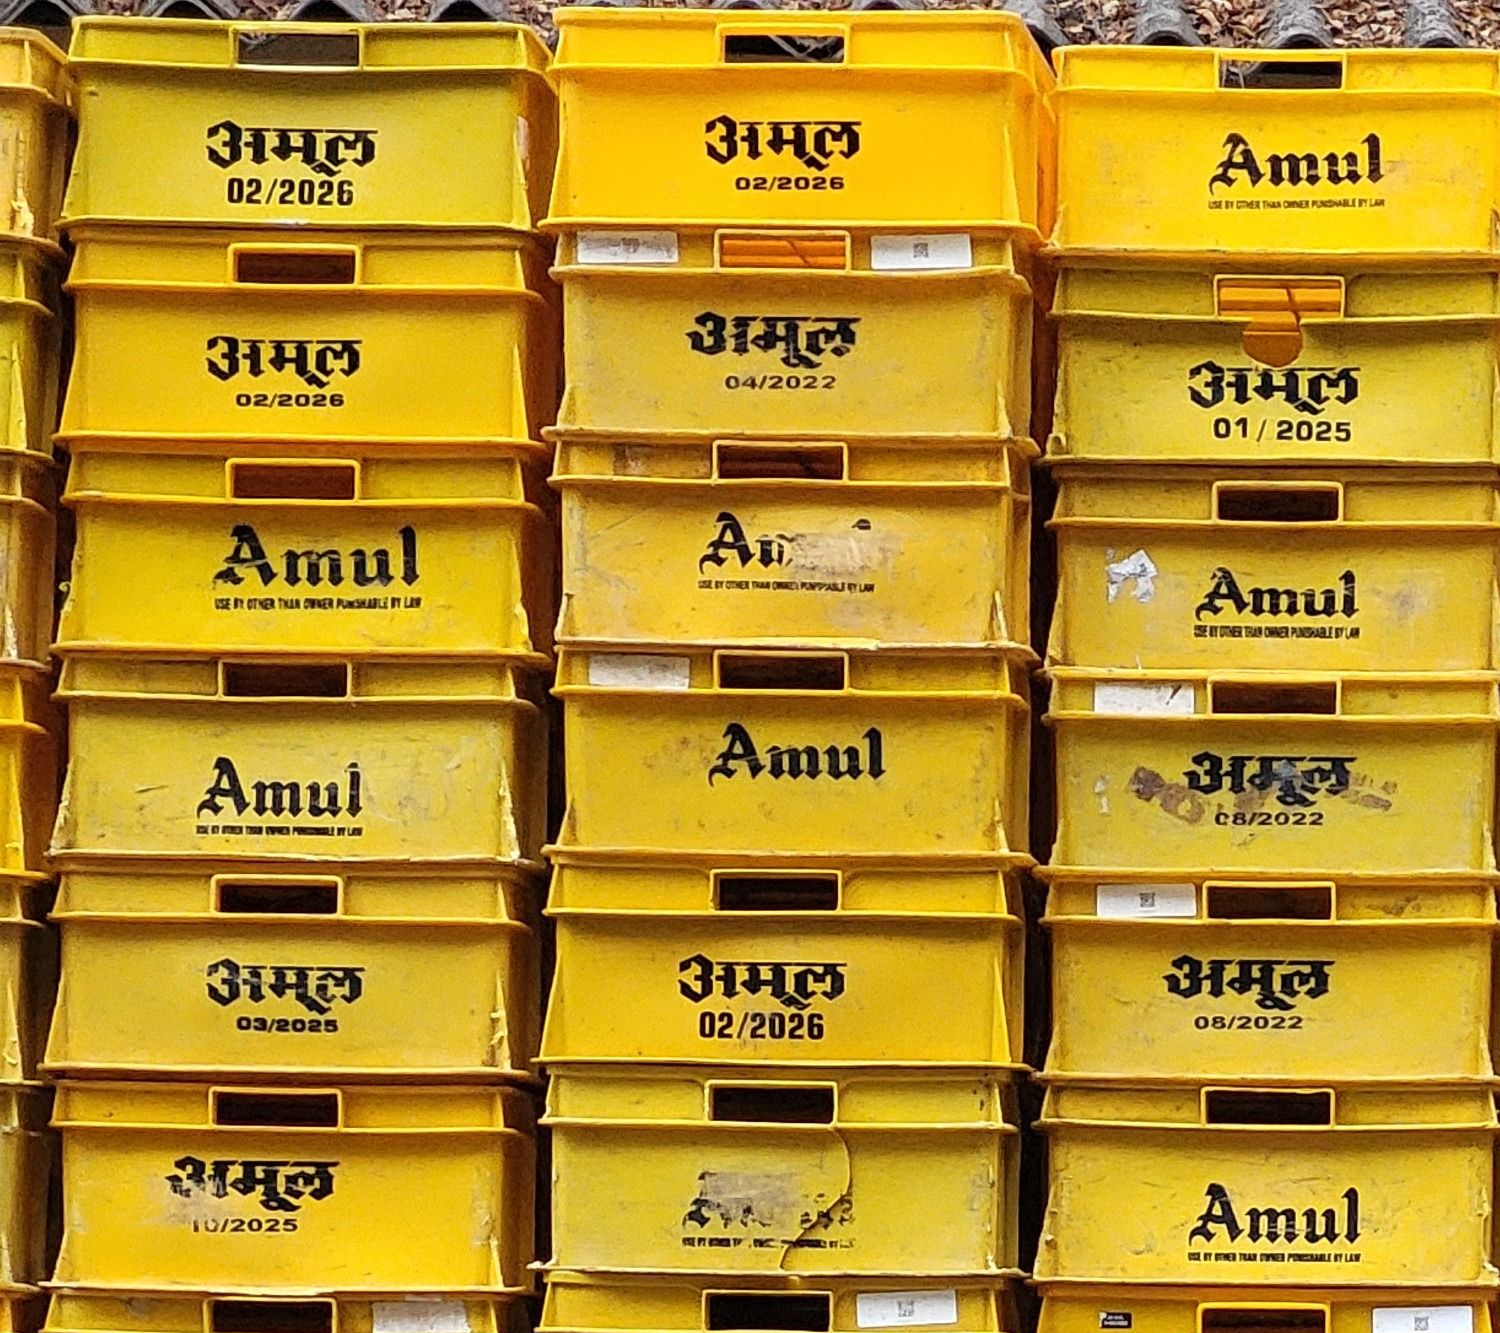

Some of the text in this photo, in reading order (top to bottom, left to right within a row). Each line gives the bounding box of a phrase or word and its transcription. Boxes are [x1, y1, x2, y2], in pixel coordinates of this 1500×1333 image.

[206, 120, 378, 174] अमूल
[704, 115, 862, 171] अमूल
[1209, 132, 1385, 195] Amul
[227, 179, 354, 206] 02/2026
[736, 176, 844, 191] 02/2026
[206, 335, 361, 388] अमूल
[686, 312, 861, 368] अमूल
[235, 393, 344, 408] 02/2026
[725, 375, 836, 390] 04/2022
[1188, 360, 1360, 416] अमूल
[1213, 417, 1248, 439] 01
[1276, 419, 1351, 443] 2025
[213, 524, 420, 587] Amul
[1195, 567, 1357, 625] Amul
[708, 721, 885, 788] Amul
[1182, 751, 1356, 806] अमूल
[196, 756, 362, 820] Amul
[205, 958, 364, 1014] अमूल
[678, 953, 847, 1009] अमूल
[1162, 954, 1336, 1010] अमूल
[236, 1017, 338, 1033] 03/2025
[698, 1013, 824, 1040] 02/2026
[1194, 1016, 1302, 1030] 08/2022
[1189, 1183, 1361, 1248] Amul
